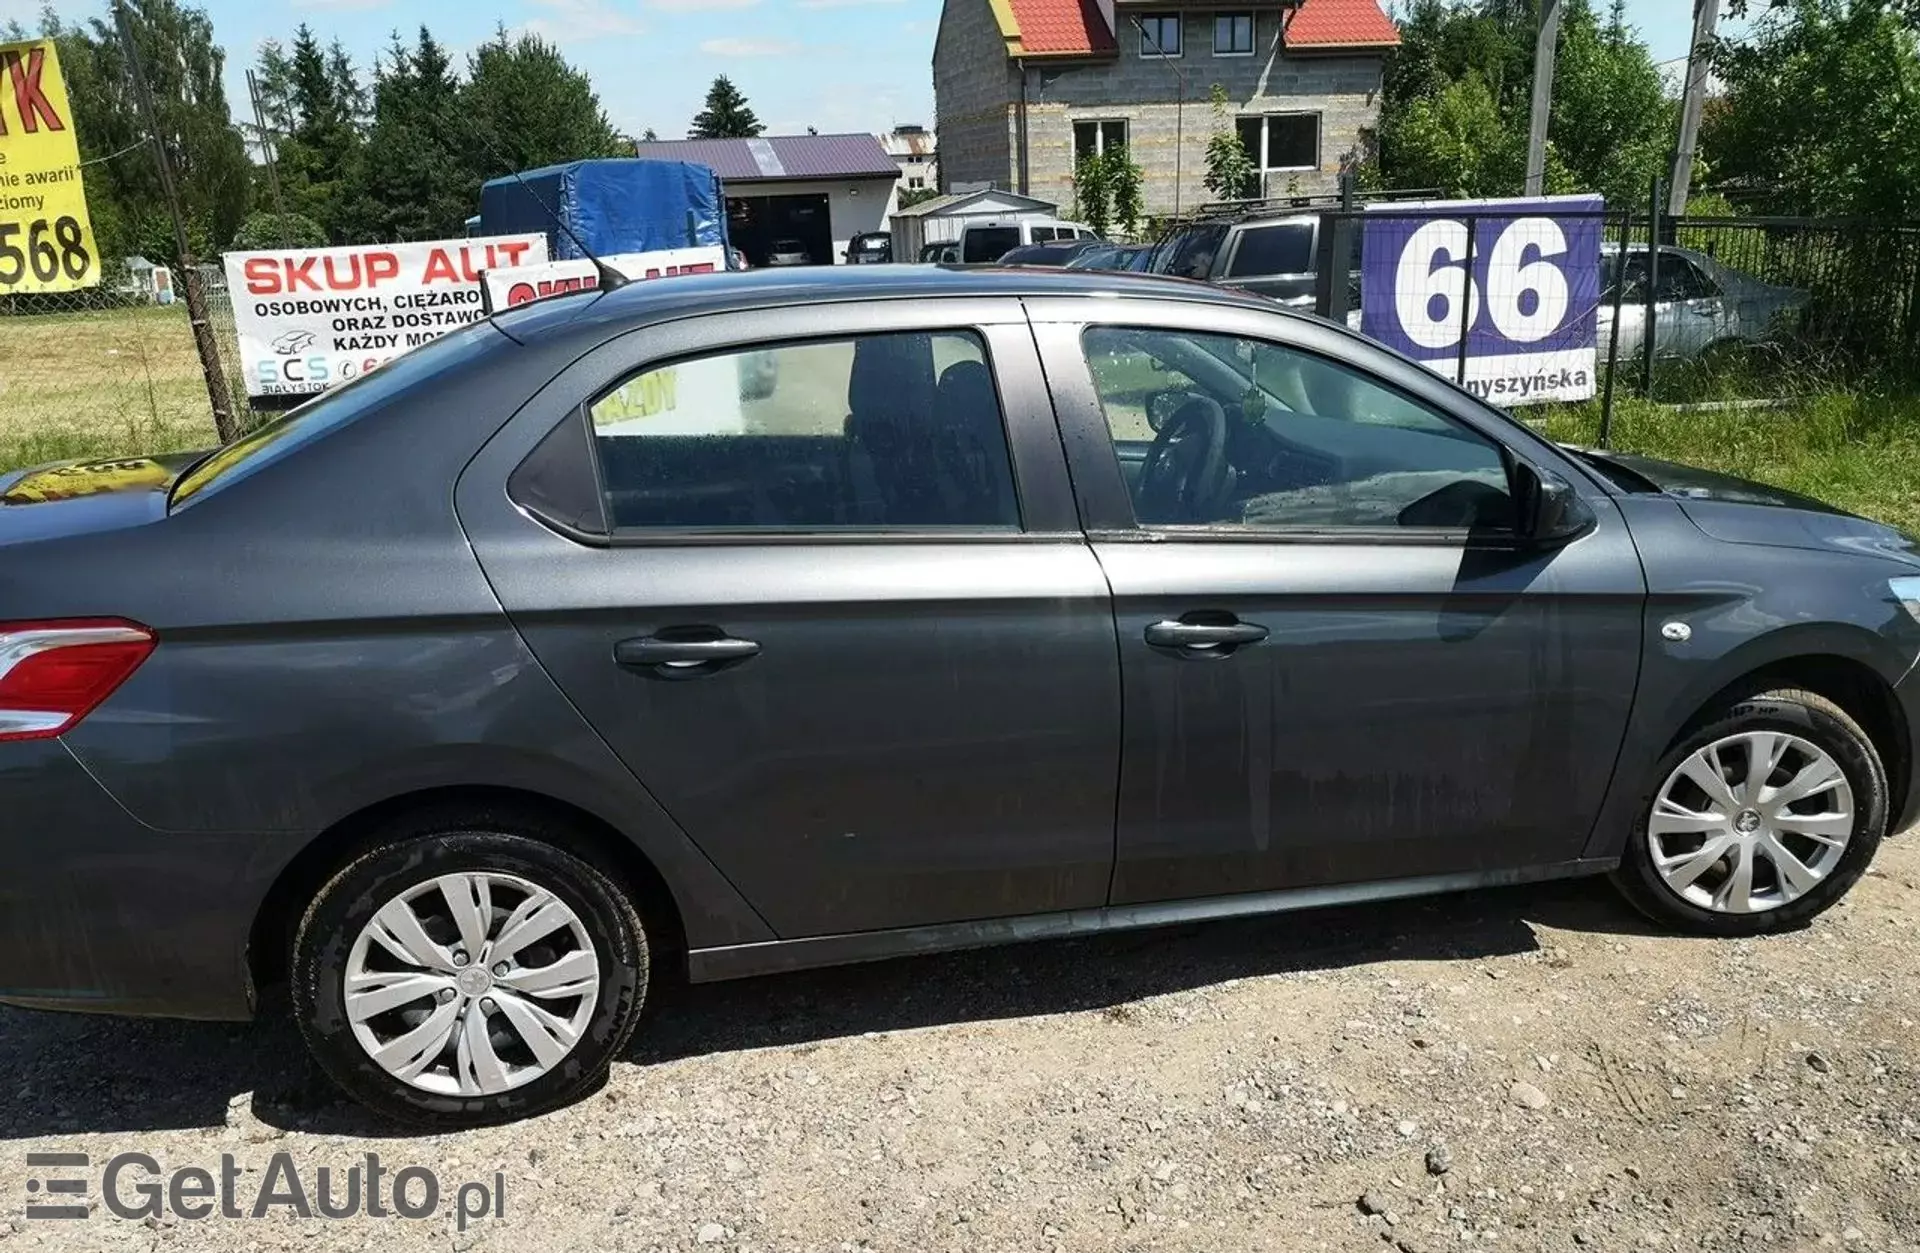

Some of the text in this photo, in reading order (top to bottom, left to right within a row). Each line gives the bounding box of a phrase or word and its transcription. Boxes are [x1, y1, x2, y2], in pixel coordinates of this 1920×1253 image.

[0, 48, 66, 135] K
[26, 165, 74, 185] awarii
[0, 215, 90, 285] 568
[244, 242, 530, 294] SKUP AUT
[1395, 217, 1568, 349] 66
[254, 289, 481, 317] OSOBOWYCH, CIĘŻARO
[332, 315, 387, 332] ORAZ
[333, 333, 399, 351] KAŻDY
[257, 356, 329, 383] SCS
[1464, 367, 1587, 399] nyszyńska
